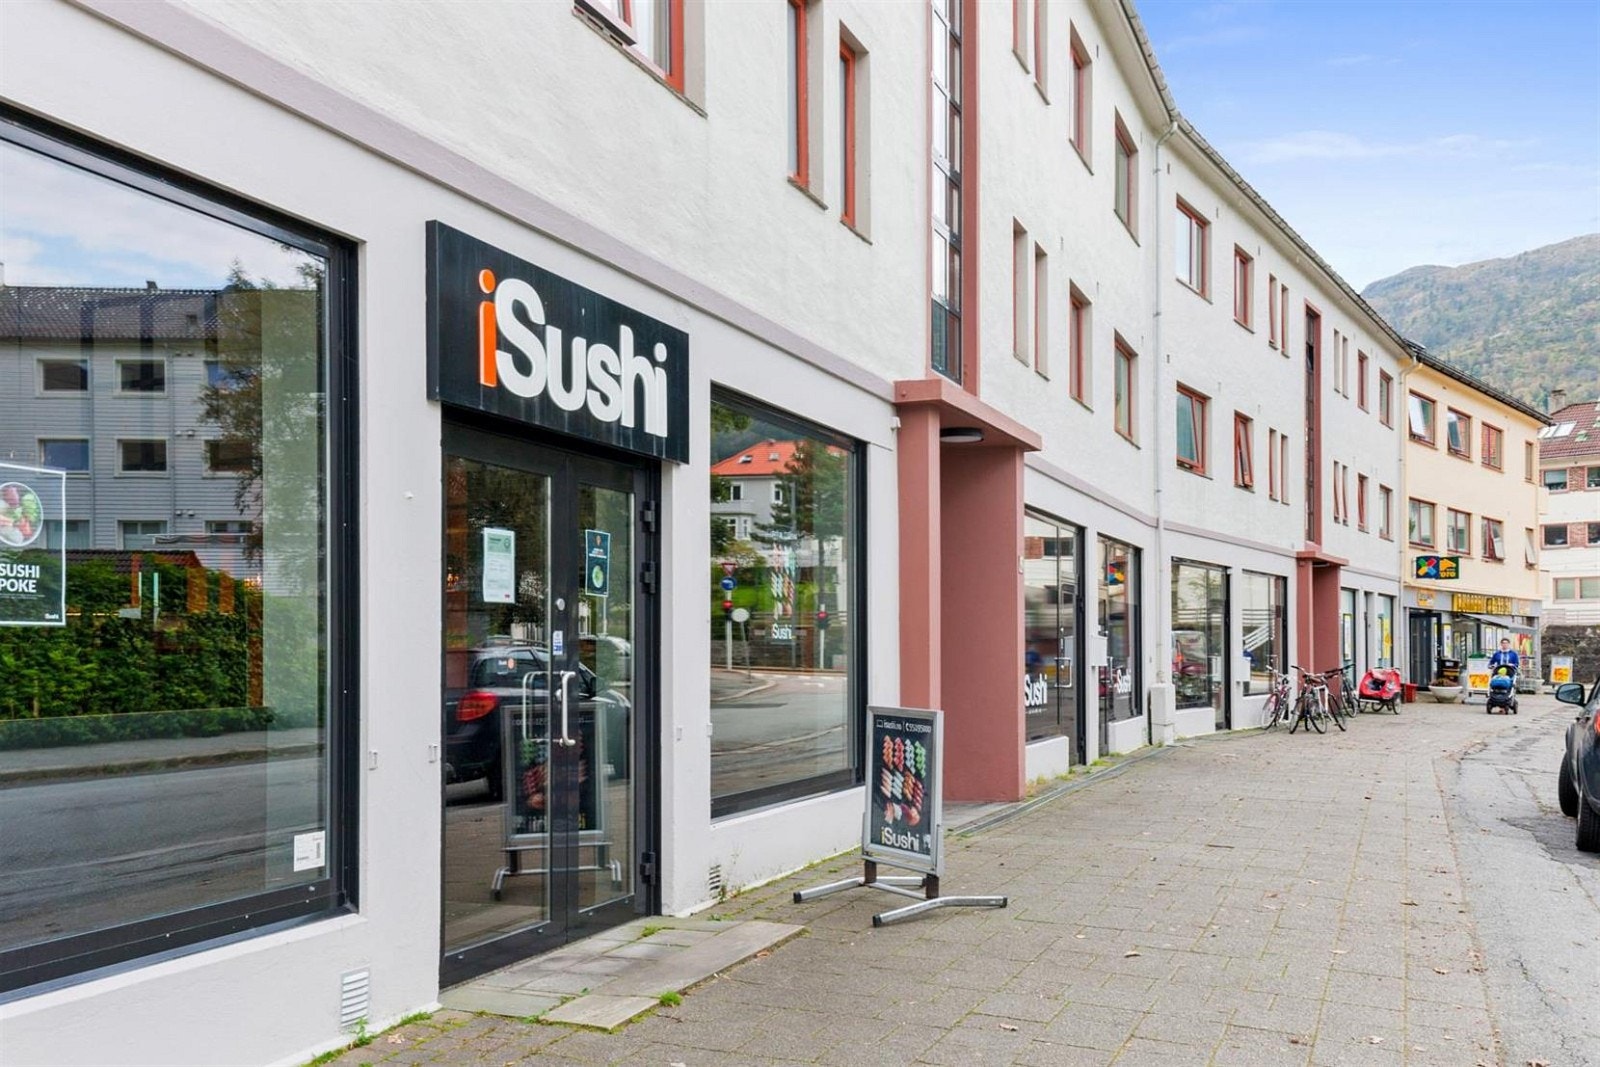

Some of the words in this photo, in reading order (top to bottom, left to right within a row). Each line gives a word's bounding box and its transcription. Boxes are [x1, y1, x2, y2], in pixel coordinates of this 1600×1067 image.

[478, 268, 668, 438] iSushi
[0, 563, 40, 578] SUSHI
[0, 578, 37, 593] POKE
[880, 826, 920, 851] iSushi
